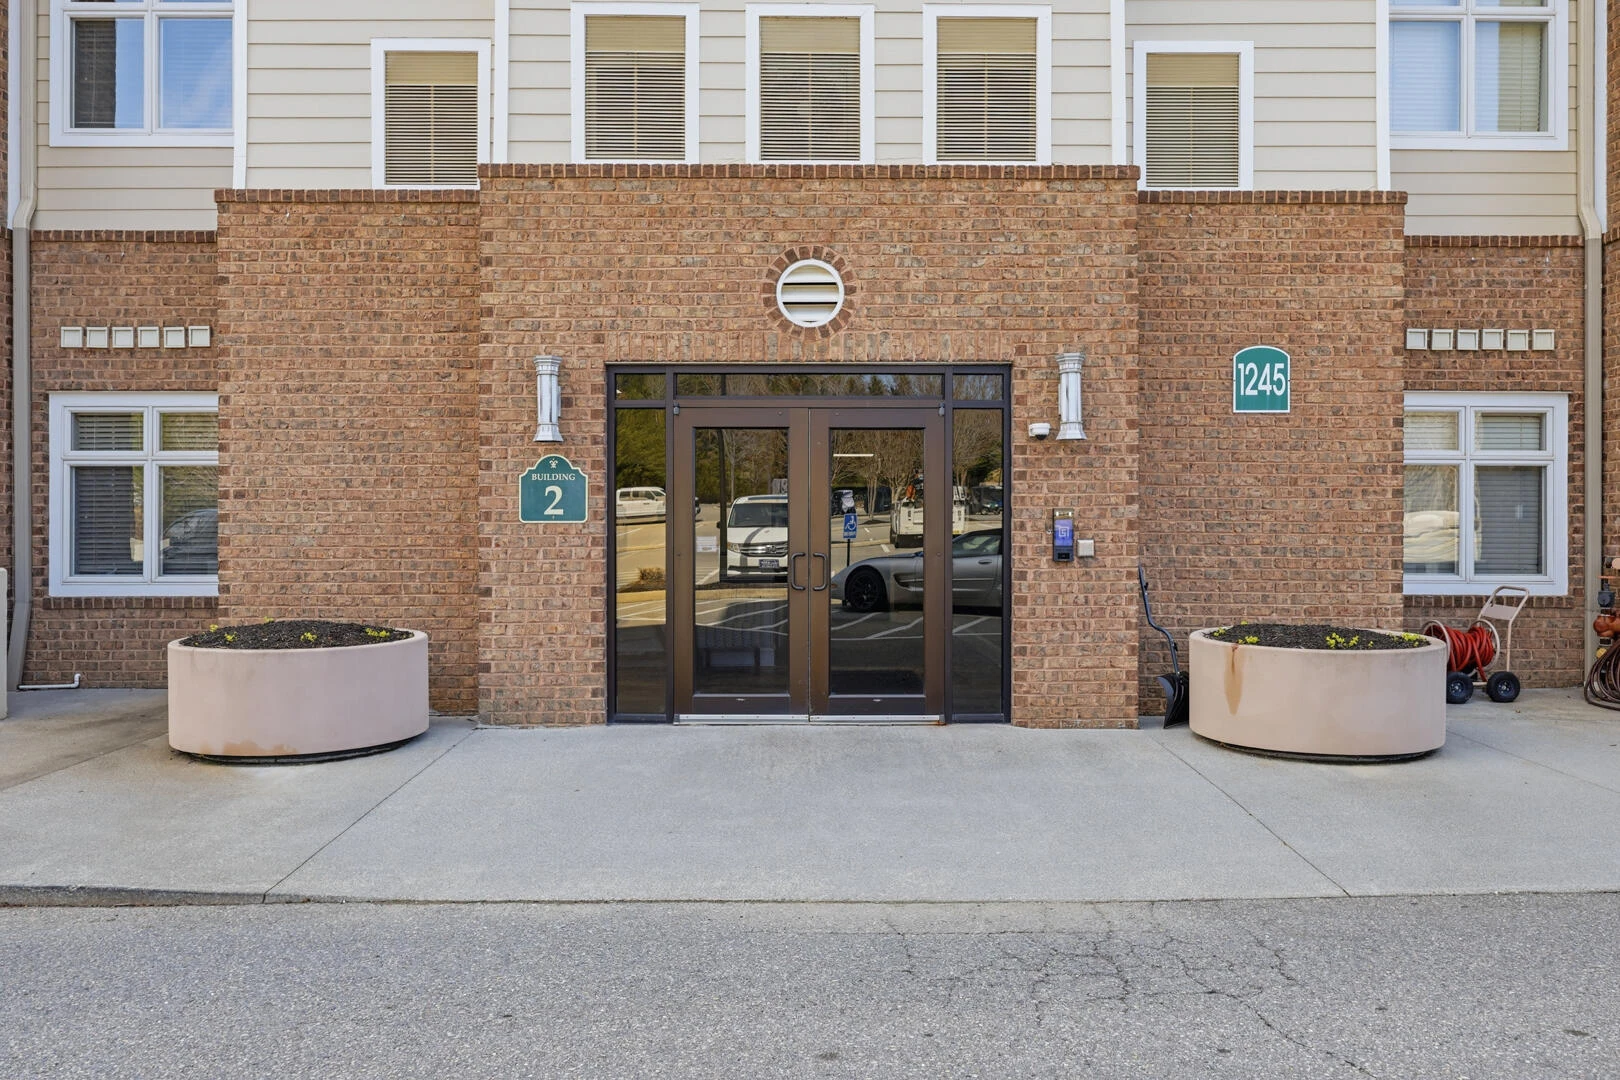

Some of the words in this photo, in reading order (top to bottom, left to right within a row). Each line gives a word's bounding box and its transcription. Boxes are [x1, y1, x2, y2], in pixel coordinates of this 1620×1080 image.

[1238, 362, 1286, 396] 1245
[531, 473, 576, 481] BUILDING
[543, 485, 564, 515] 2
